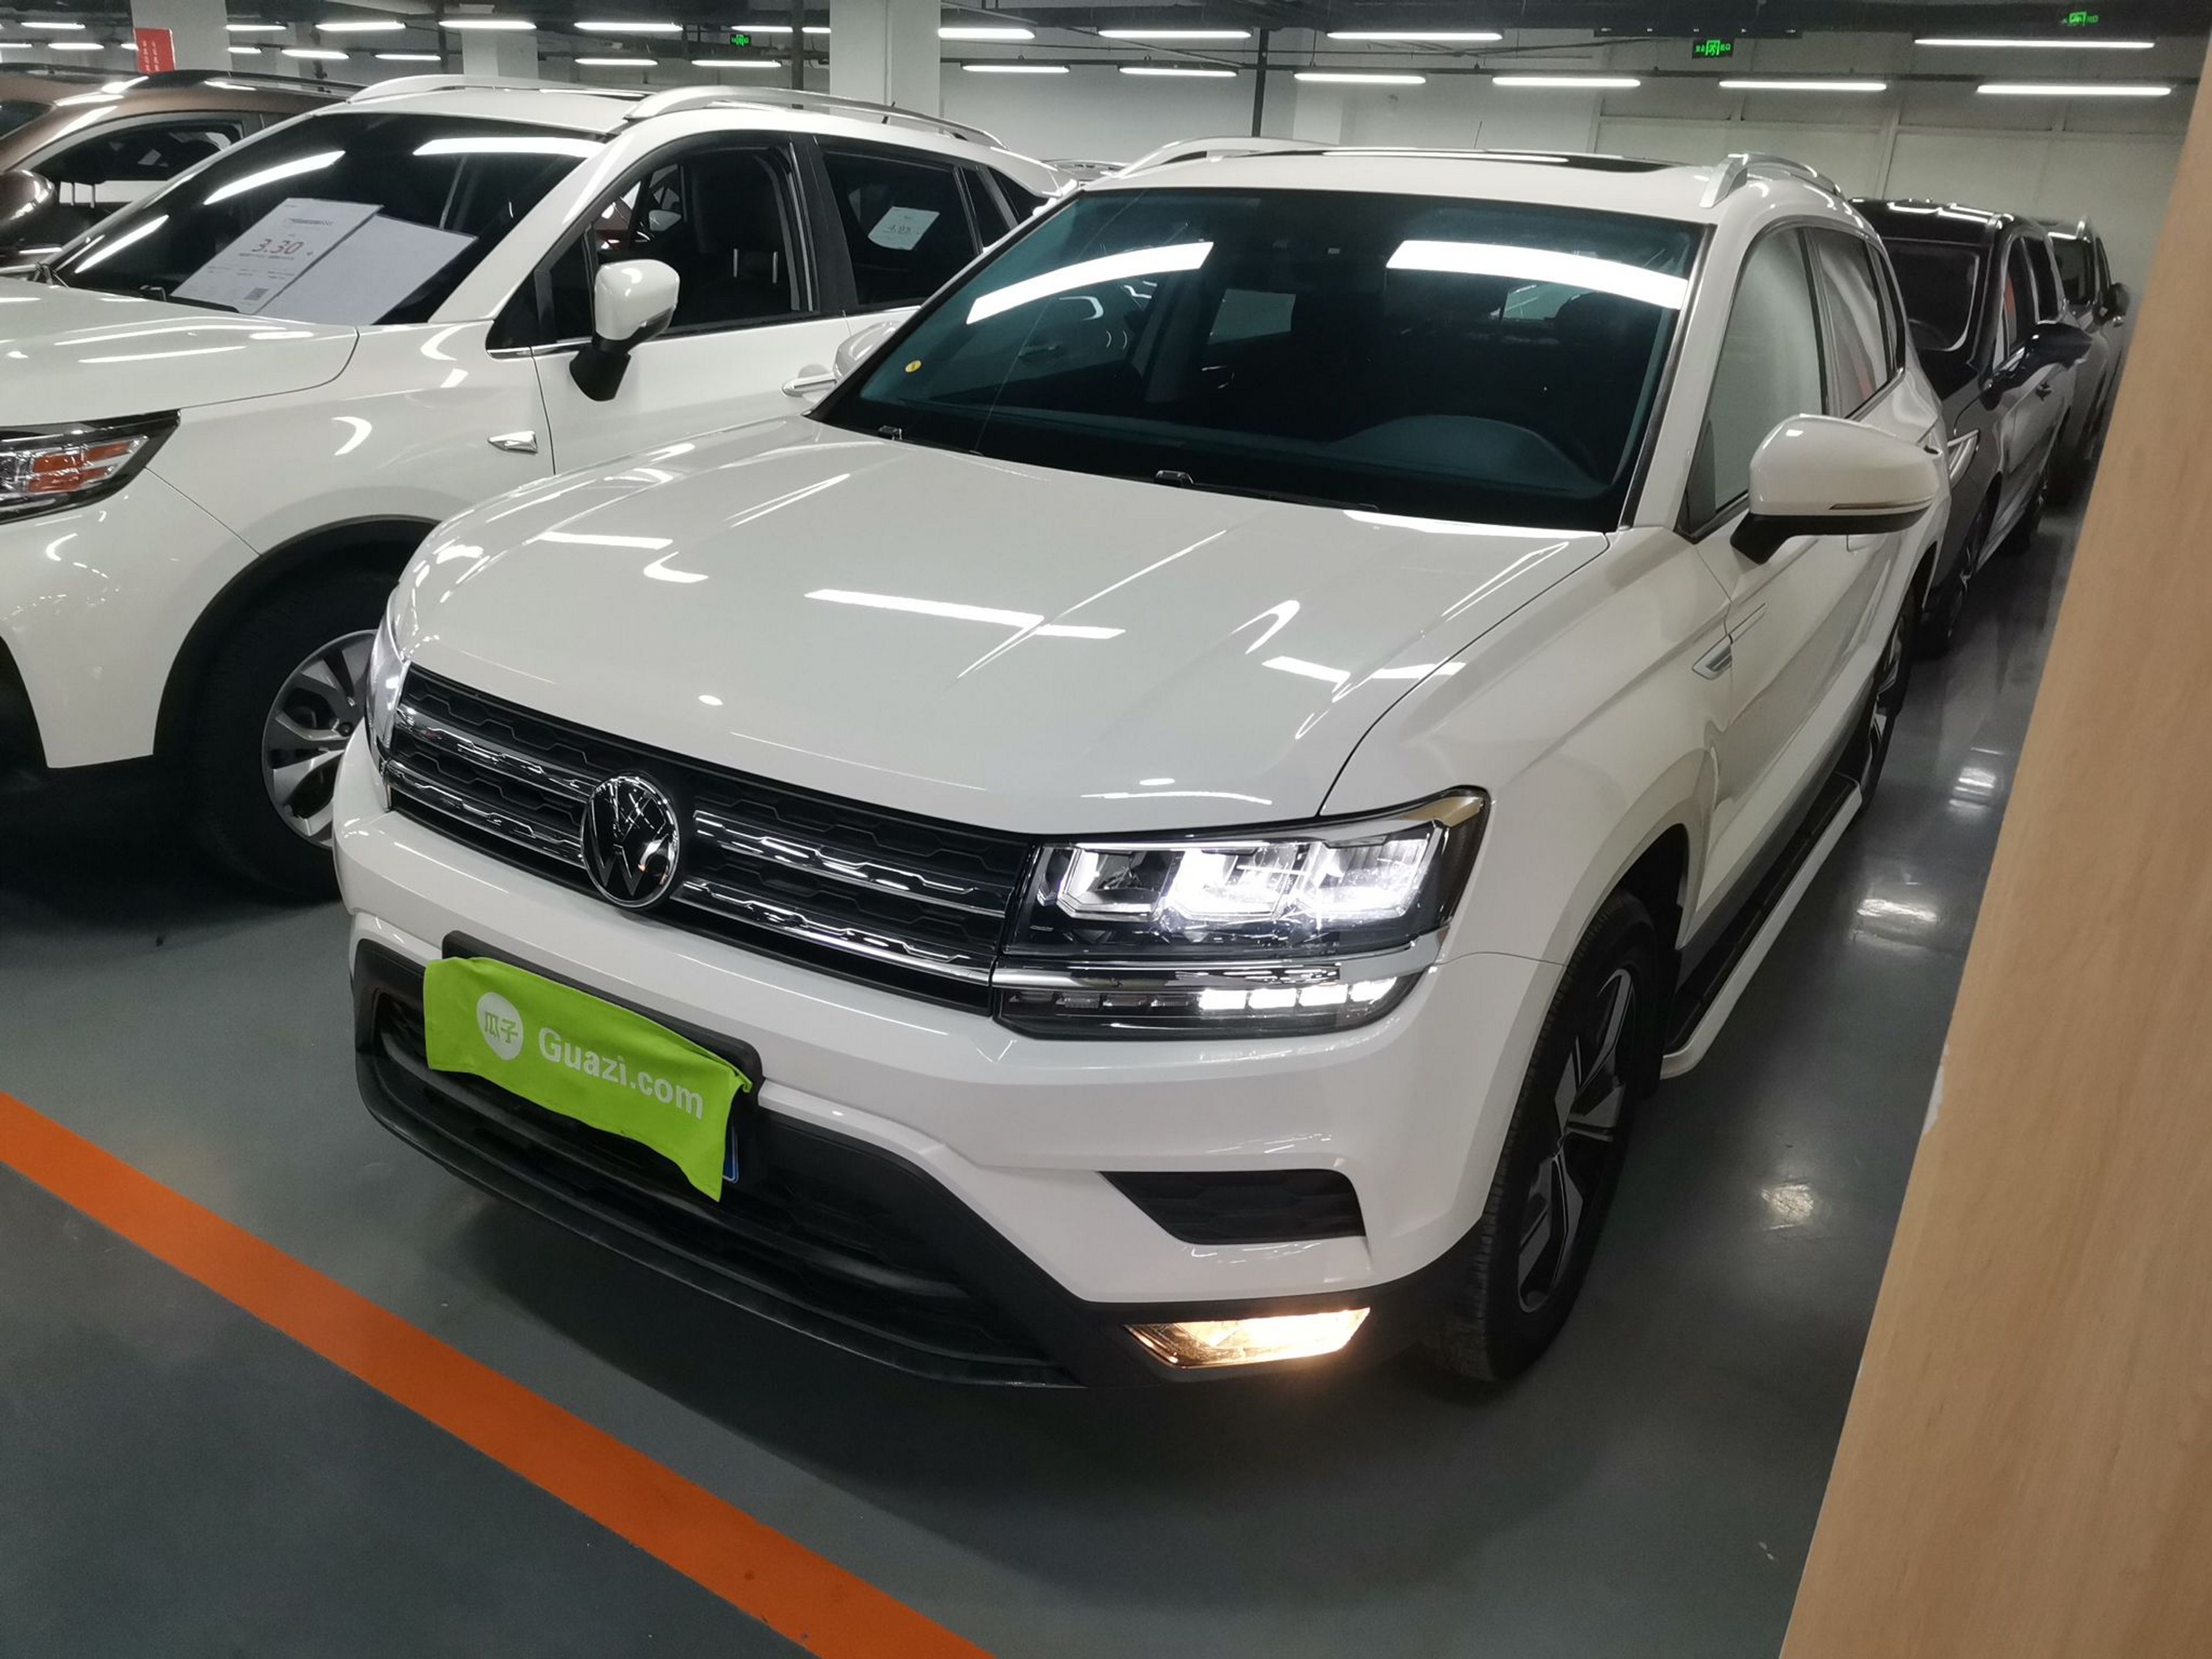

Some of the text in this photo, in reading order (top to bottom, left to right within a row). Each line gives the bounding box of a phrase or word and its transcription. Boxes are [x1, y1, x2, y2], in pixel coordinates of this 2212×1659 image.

[251, 238, 304, 255] 3.30
[484, 1011, 518, 1044] 瓜子
[539, 1027, 703, 1120] Guazi.com
